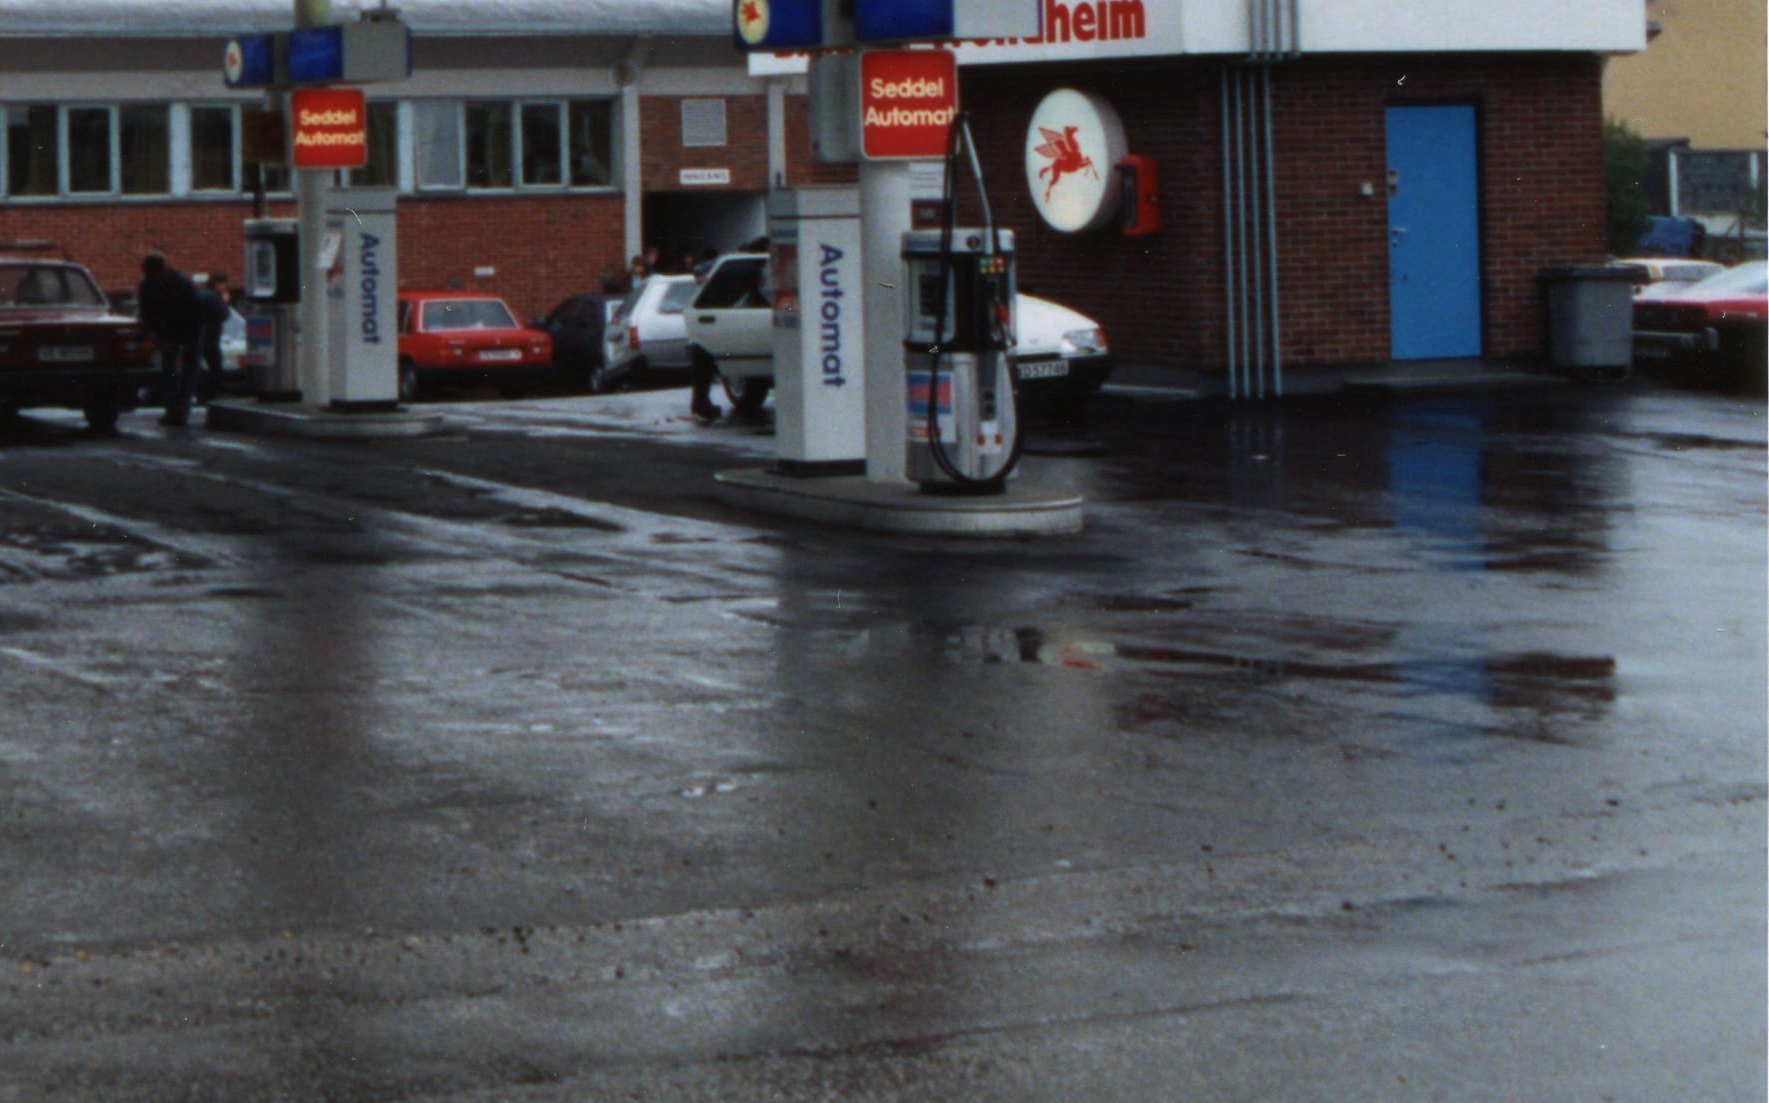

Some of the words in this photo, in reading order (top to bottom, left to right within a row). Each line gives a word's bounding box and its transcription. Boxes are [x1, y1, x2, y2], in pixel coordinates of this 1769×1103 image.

[871, 78, 944, 99] Seddel
[300, 109, 356, 125] Seddel
[864, 106, 955, 128] Automat
[295, 130, 366, 146] Automat
[360, 231, 381, 344] Automat
[820, 243, 846, 388] Automat
